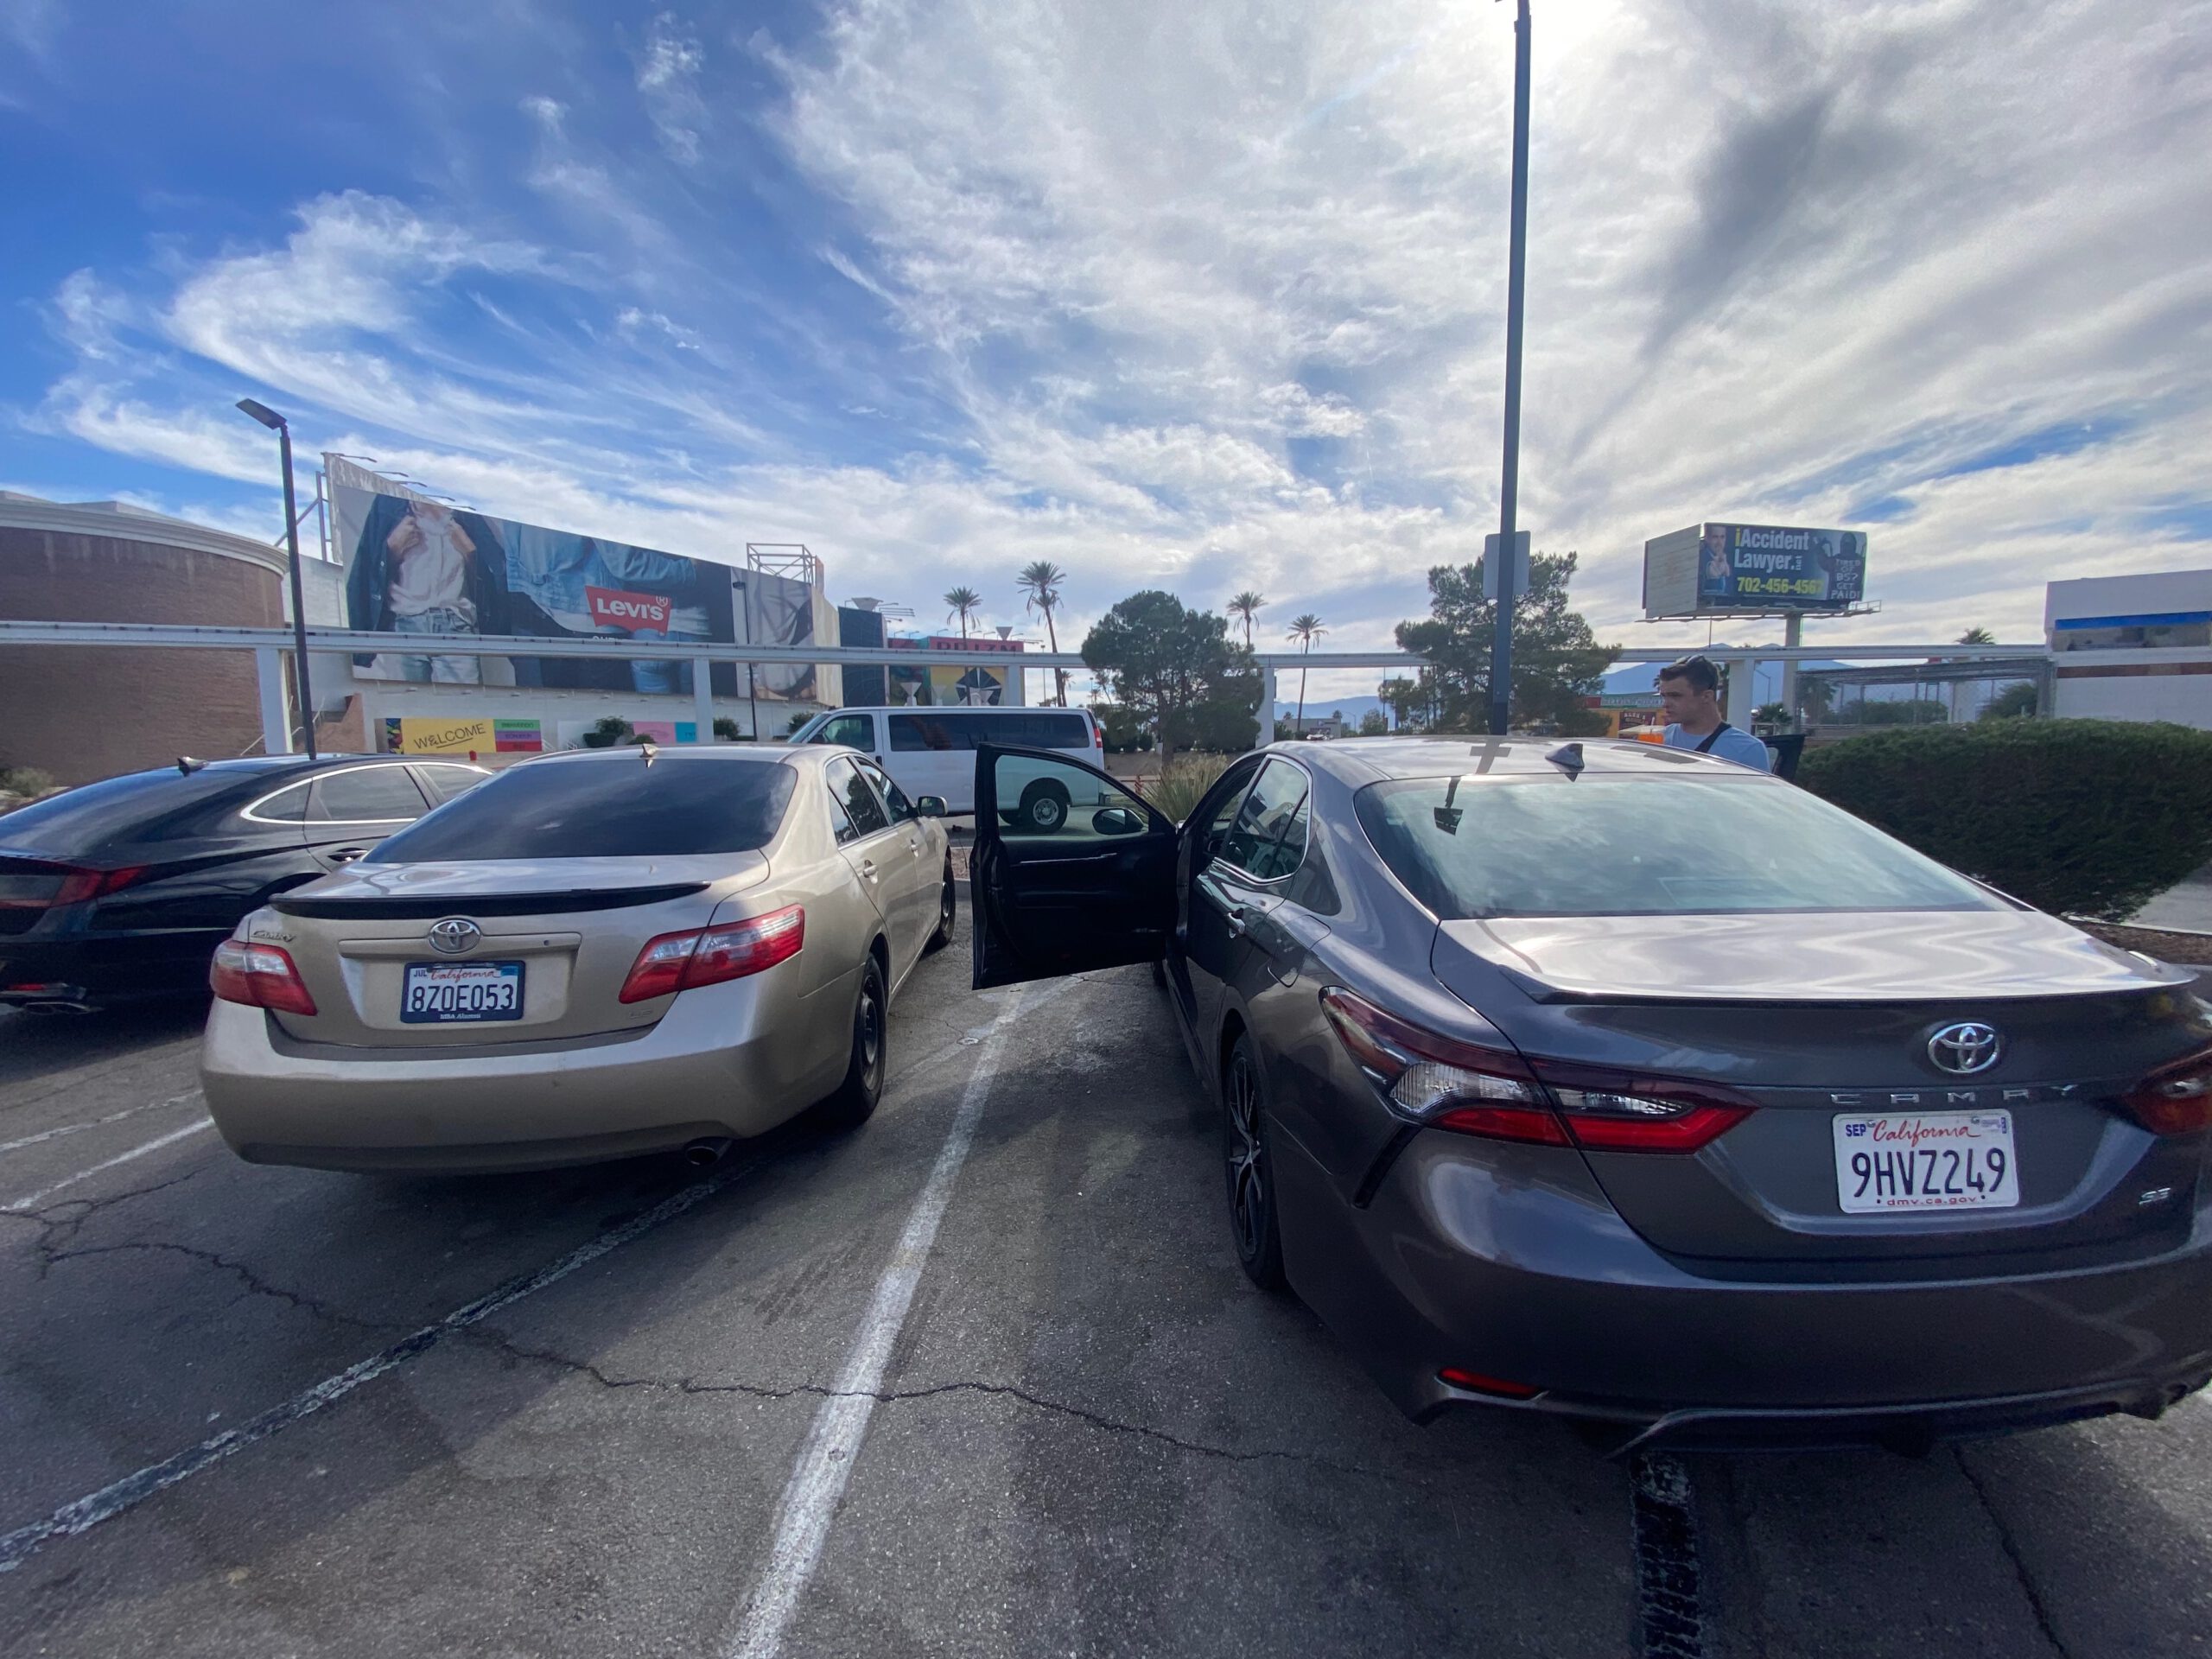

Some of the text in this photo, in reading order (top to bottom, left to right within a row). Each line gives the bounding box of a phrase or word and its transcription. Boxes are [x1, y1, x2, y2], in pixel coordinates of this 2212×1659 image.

[1735, 527, 1809, 550] iAccident
[1836, 572, 1859, 582] BS?
[431, 969, 500, 983] California
[1831, 1084, 2078, 1105] CAMRY
[1846, 1123, 1866, 1137] SEP
[1872, 1120, 1981, 1147] California
[1851, 1147, 2005, 1198] 9HVZ249
